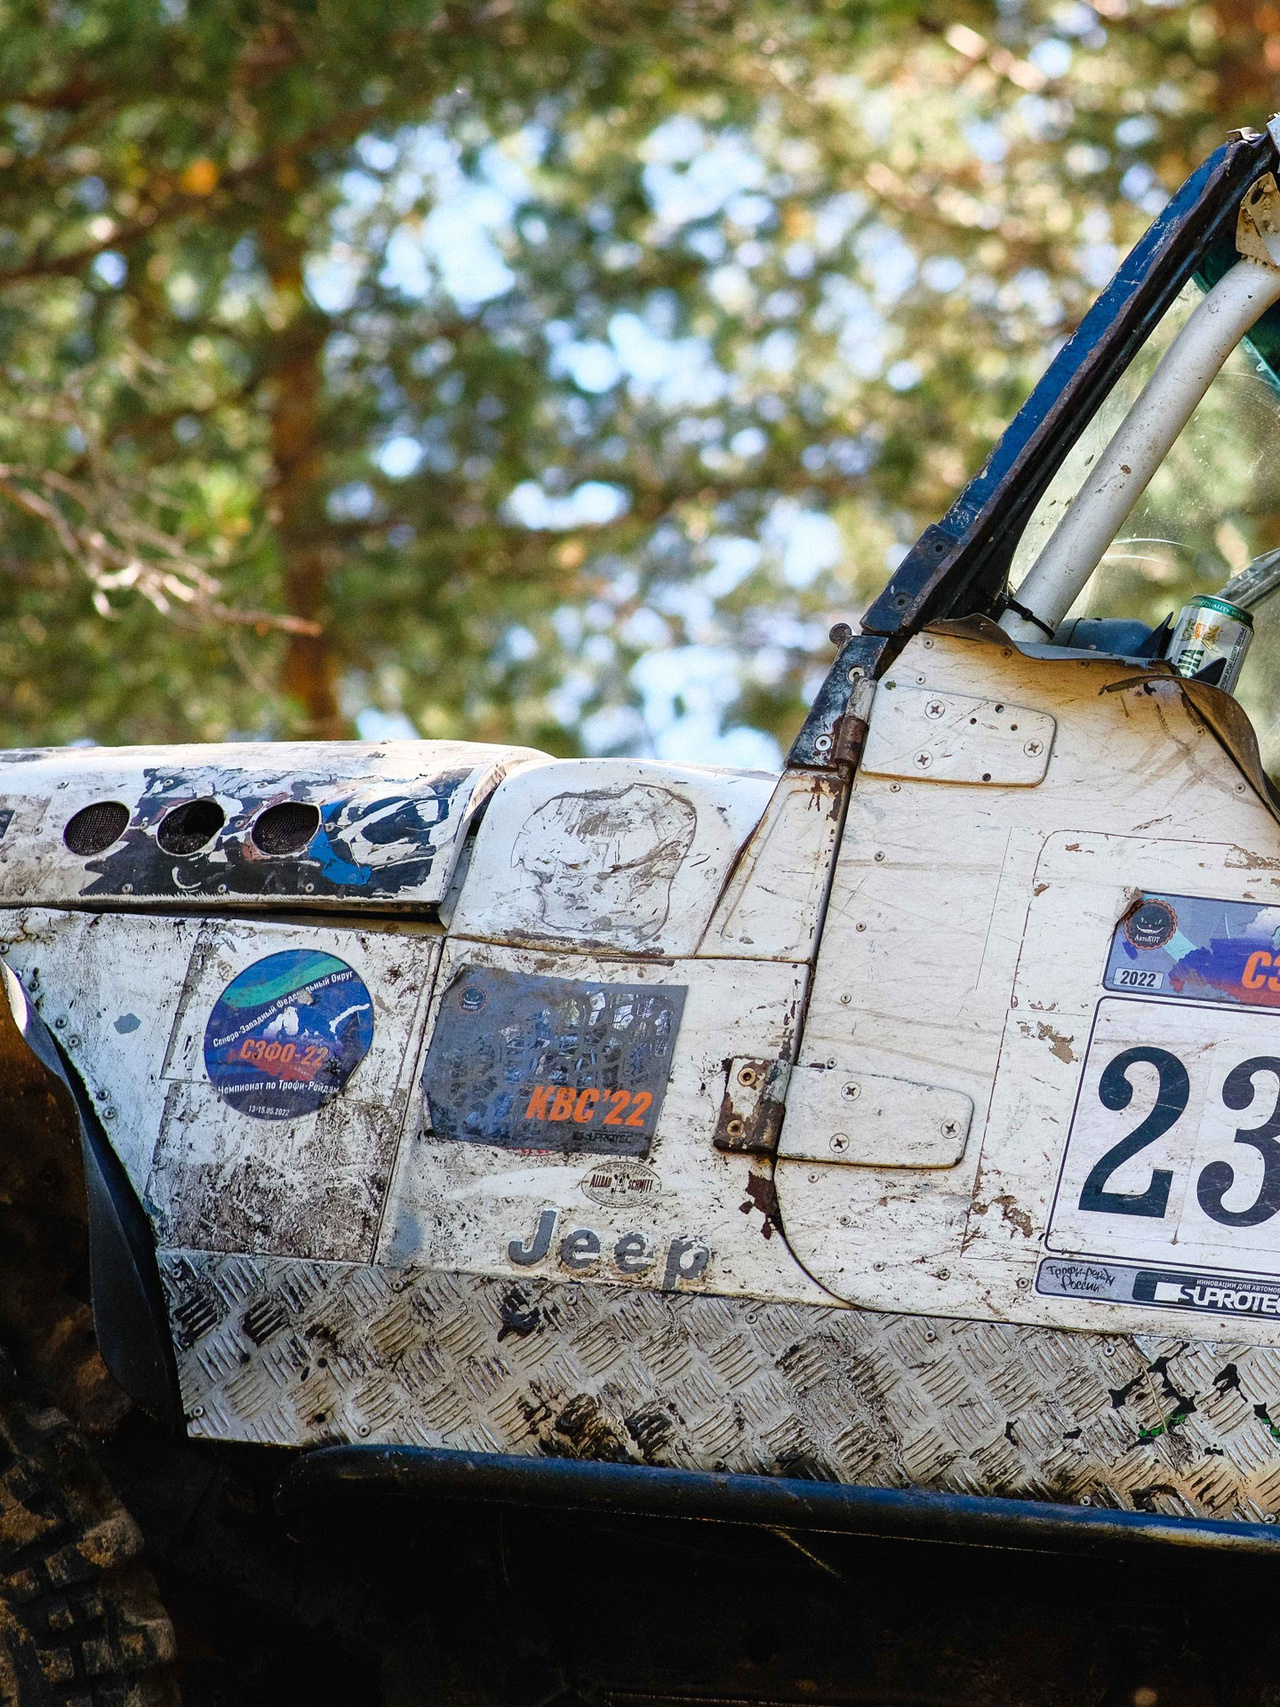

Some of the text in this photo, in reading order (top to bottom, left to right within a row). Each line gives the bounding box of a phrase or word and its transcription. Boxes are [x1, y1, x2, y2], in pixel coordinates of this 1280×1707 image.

[276, 977, 330, 1009] Федельный
[331, 970, 353, 985] Округ
[1120, 970, 1156, 988] 2022
[240, 1039, 329, 1066] СЗФО-22
[218, 1082, 264, 1095] Чемпионат
[265, 1082, 276, 1090] по
[507, 1210, 710, 1290] Jeep
[1196, 1279, 1236, 1289] ИННОВАЦИИ
[1237, 1283, 1251, 1291] ДЛЯ
